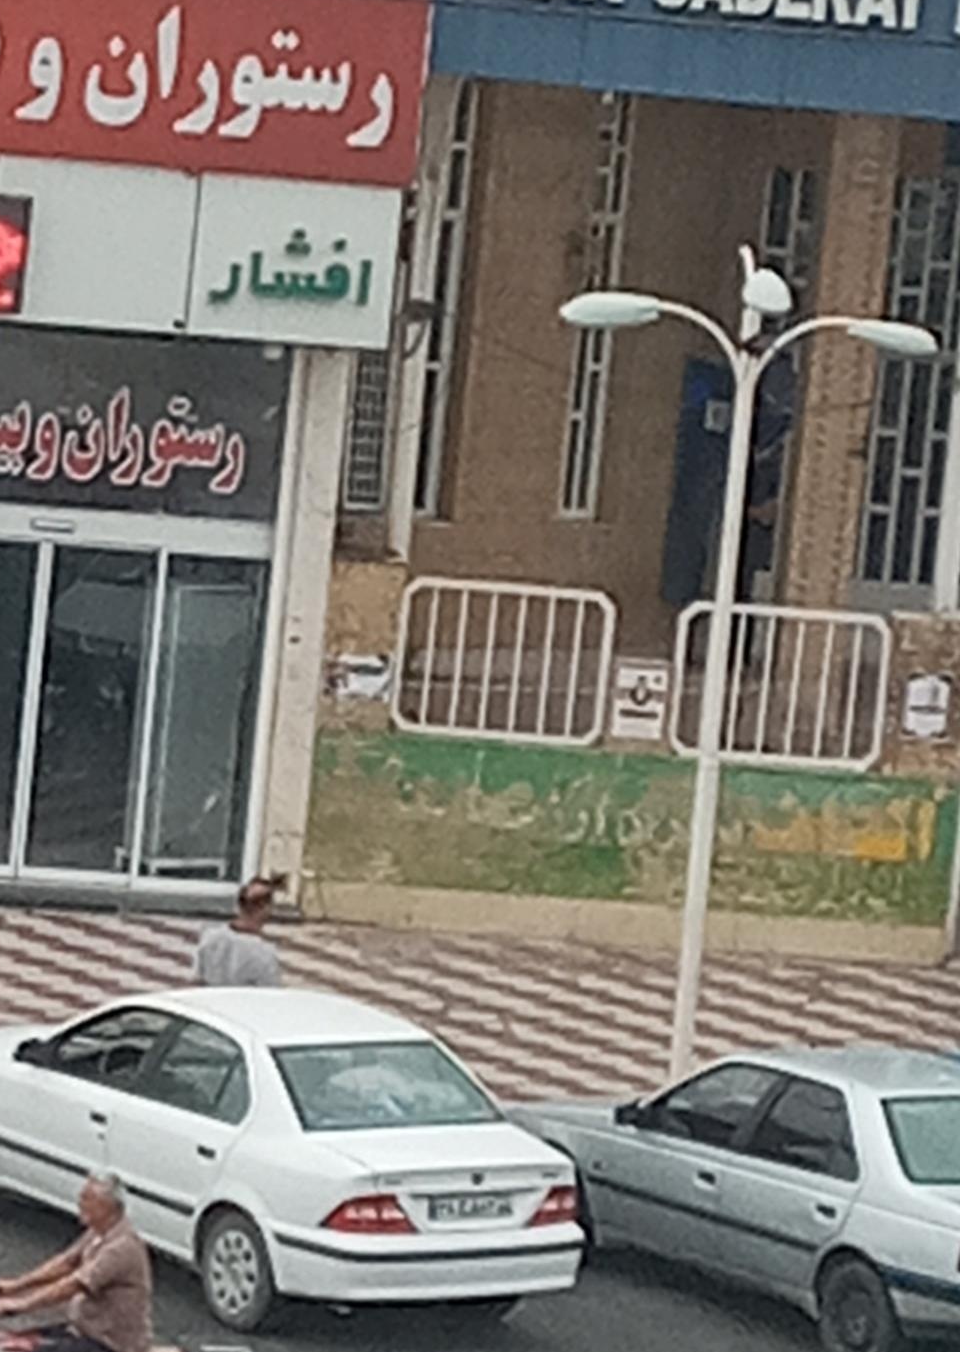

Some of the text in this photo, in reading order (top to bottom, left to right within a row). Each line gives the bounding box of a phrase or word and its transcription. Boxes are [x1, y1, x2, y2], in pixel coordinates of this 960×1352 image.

[14, 35, 63, 121] و
[83, 5, 394, 147] رستوران
[207, 228, 373, 307] افشار
[62, 386, 245, 494] رستوران
